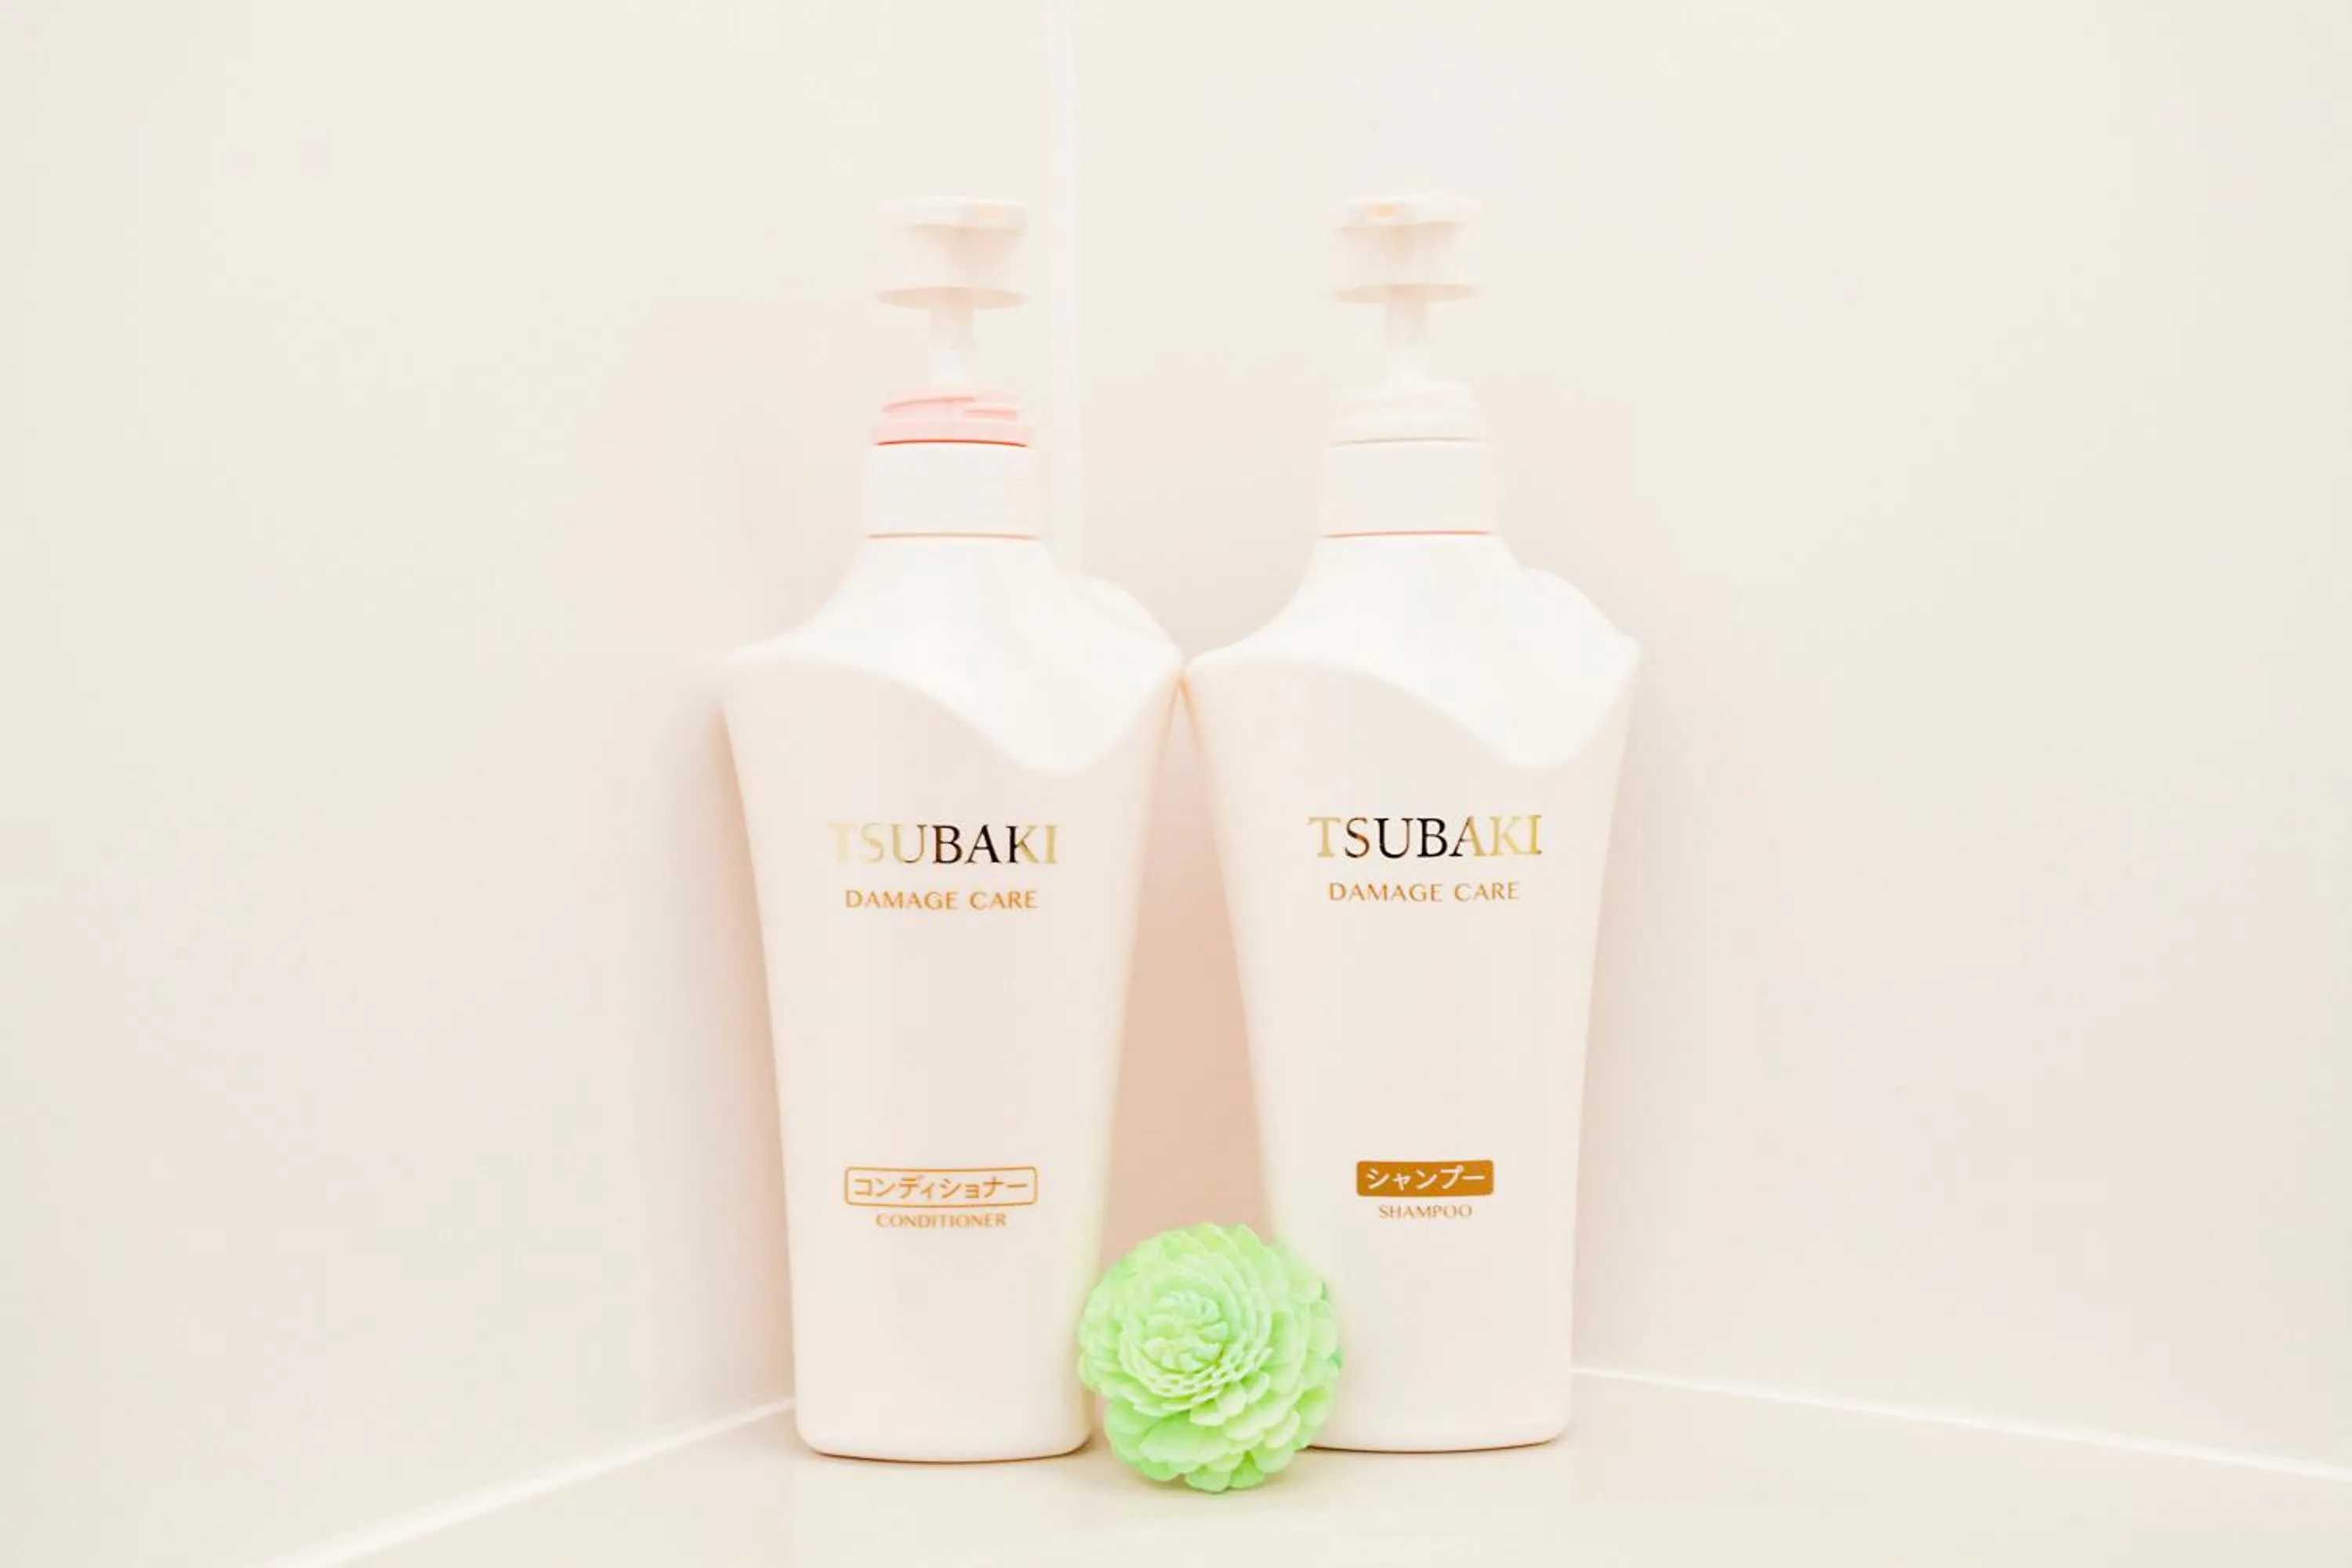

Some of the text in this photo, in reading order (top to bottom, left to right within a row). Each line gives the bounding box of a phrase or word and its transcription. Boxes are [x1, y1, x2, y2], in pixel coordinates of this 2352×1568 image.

[827, 822, 1058, 864] TSUBAKI
[1307, 815, 1543, 858] TSUBAKI
[844, 888, 1040, 910] DAMAGE CARE
[1328, 880, 1521, 902] DAMAGE CARE
[853, 1175, 1029, 1200] コンディショナー
[1367, 1164, 1486, 1191] シャンプー
[875, 1213, 1007, 1229] CONDITIONER
[1377, 1203, 1473, 1219] SHAMPOO
